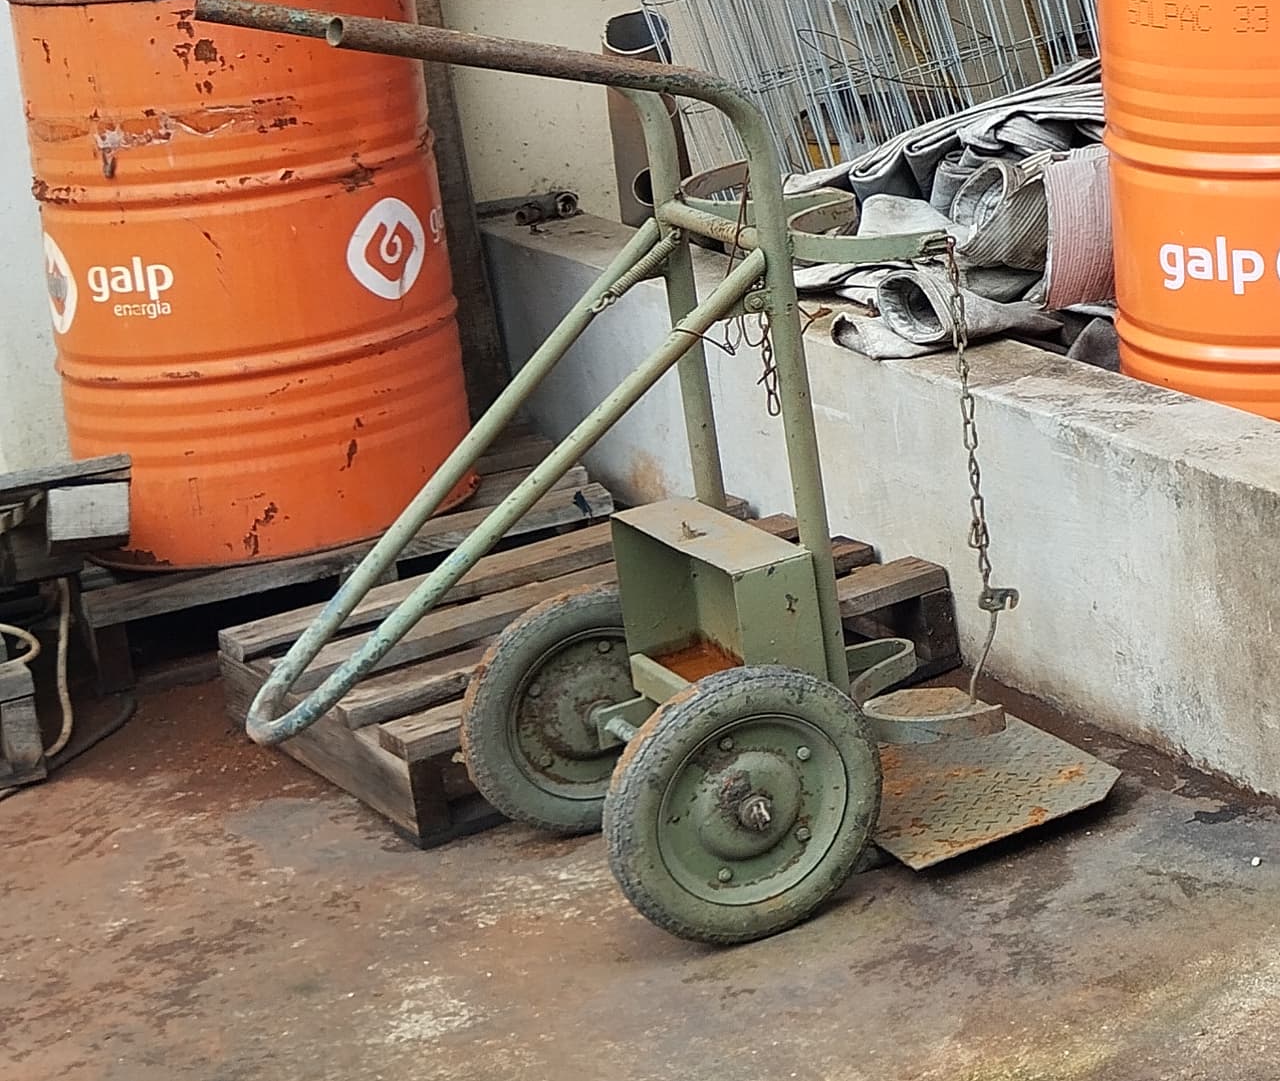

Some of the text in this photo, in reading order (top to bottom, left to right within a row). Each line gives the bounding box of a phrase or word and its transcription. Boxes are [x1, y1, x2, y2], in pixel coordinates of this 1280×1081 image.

[1232, 5, 1270, 34] 33
[87, 256, 175, 302] galp
[1159, 235, 1265, 295] galp
[114, 299, 172, 319] energia
